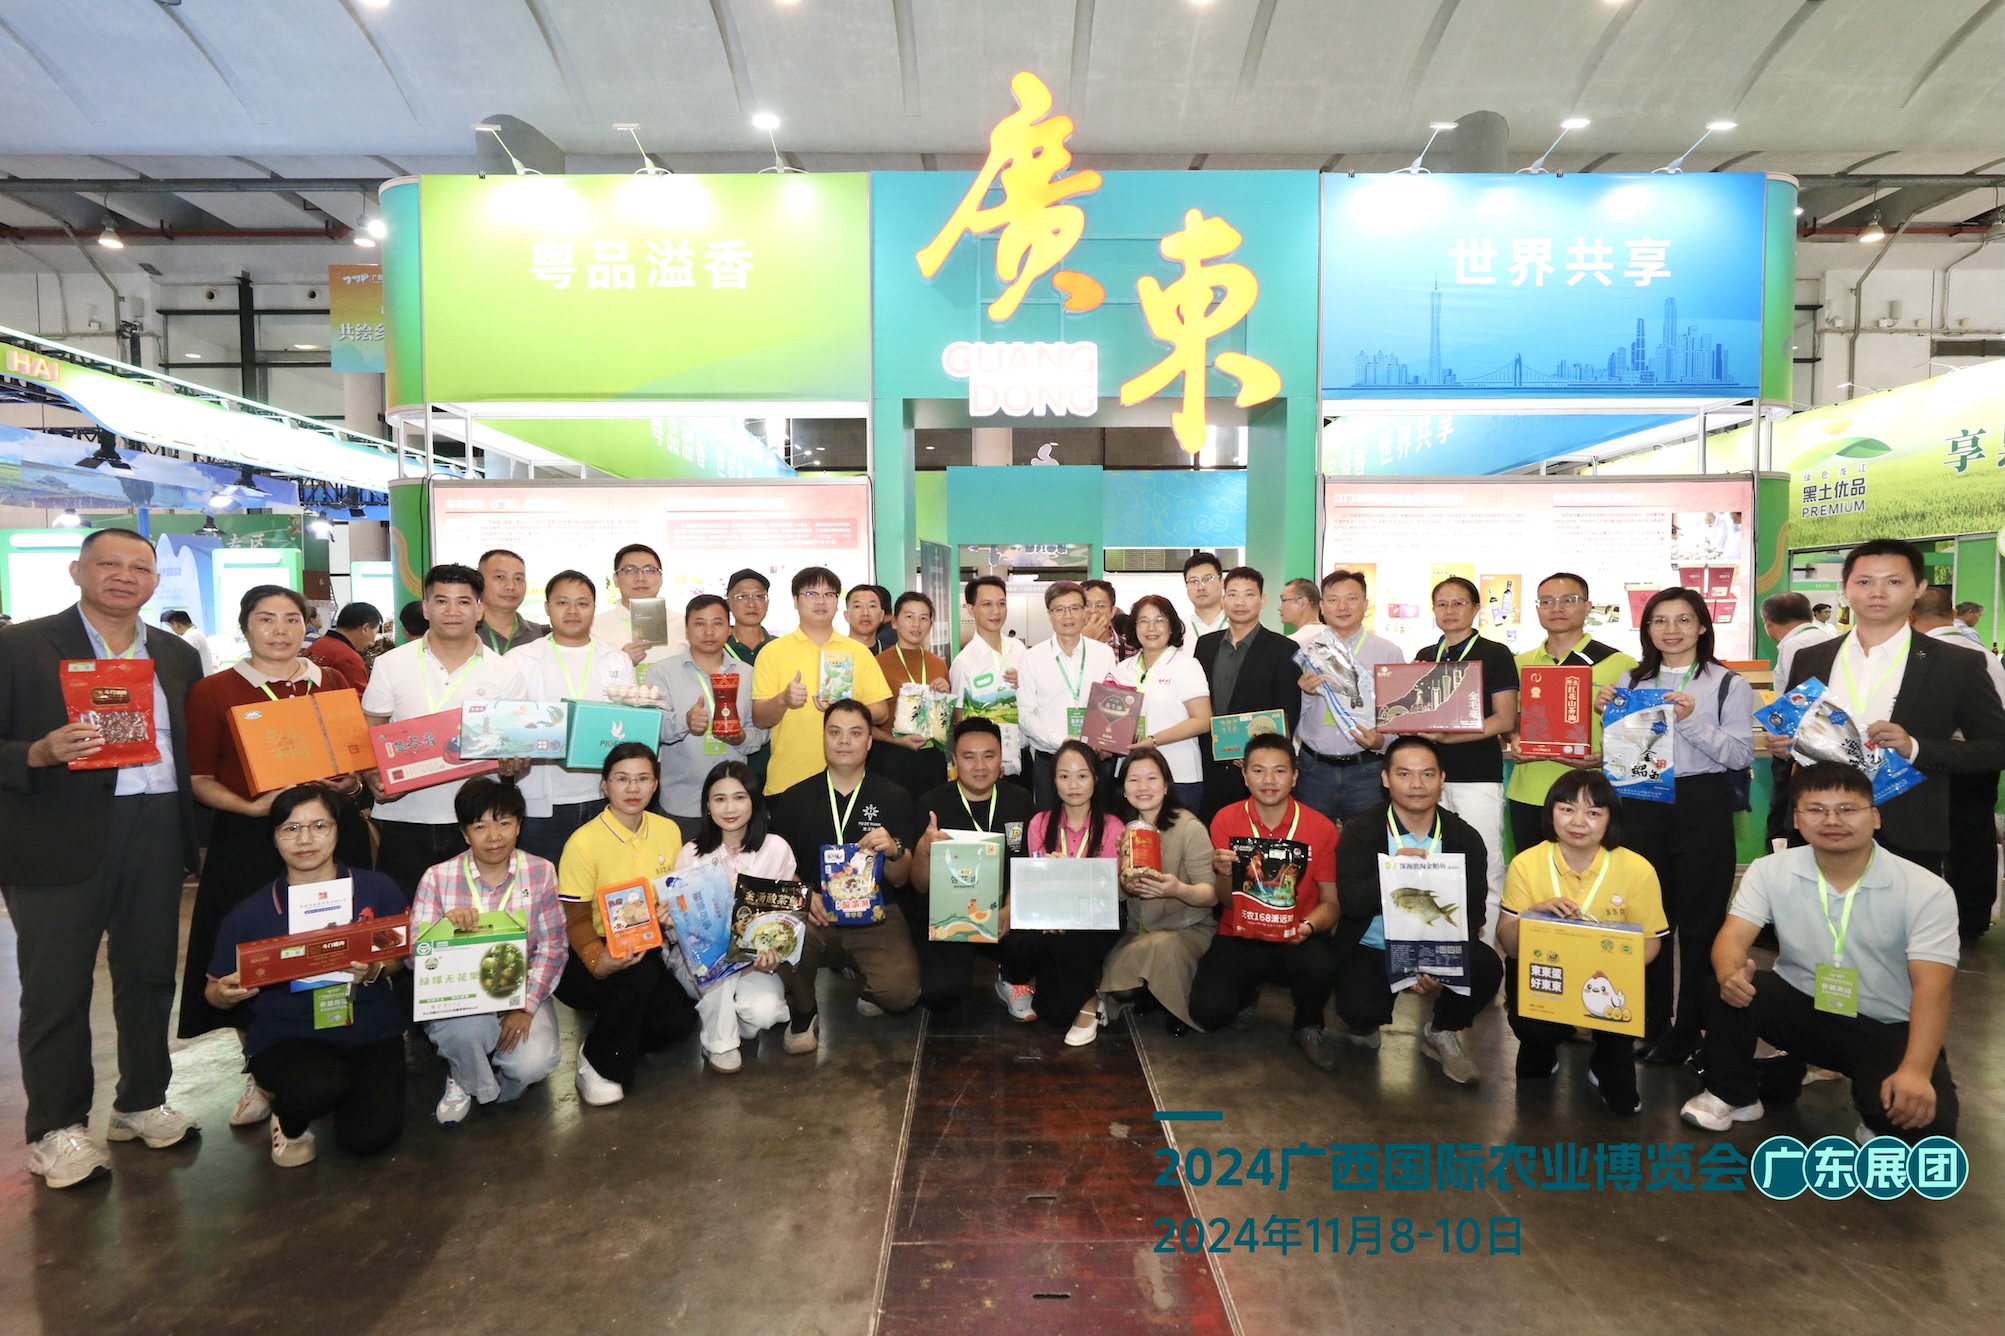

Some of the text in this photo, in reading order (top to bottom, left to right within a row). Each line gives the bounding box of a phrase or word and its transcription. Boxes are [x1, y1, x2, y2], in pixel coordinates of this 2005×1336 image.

[528, 239, 754, 290] 粤品溢香
[915, 71, 1282, 454] 廣東
[1449, 237, 1672, 287] 世界共享
[7, 350, 61, 382] HAI
[944, 342, 1097, 378] GUANG
[971, 382, 1097, 416] DONG
[1379, 415, 1455, 466] 世界共享
[1943, 427, 2005, 476] 享
[1803, 463, 1867, 482] 绿色龙江
[1802, 477, 1867, 504] 黑土优品
[1801, 499, 1866, 518] PREMIUM
[745, 890, 799, 906] 金汤酸菜鱼
